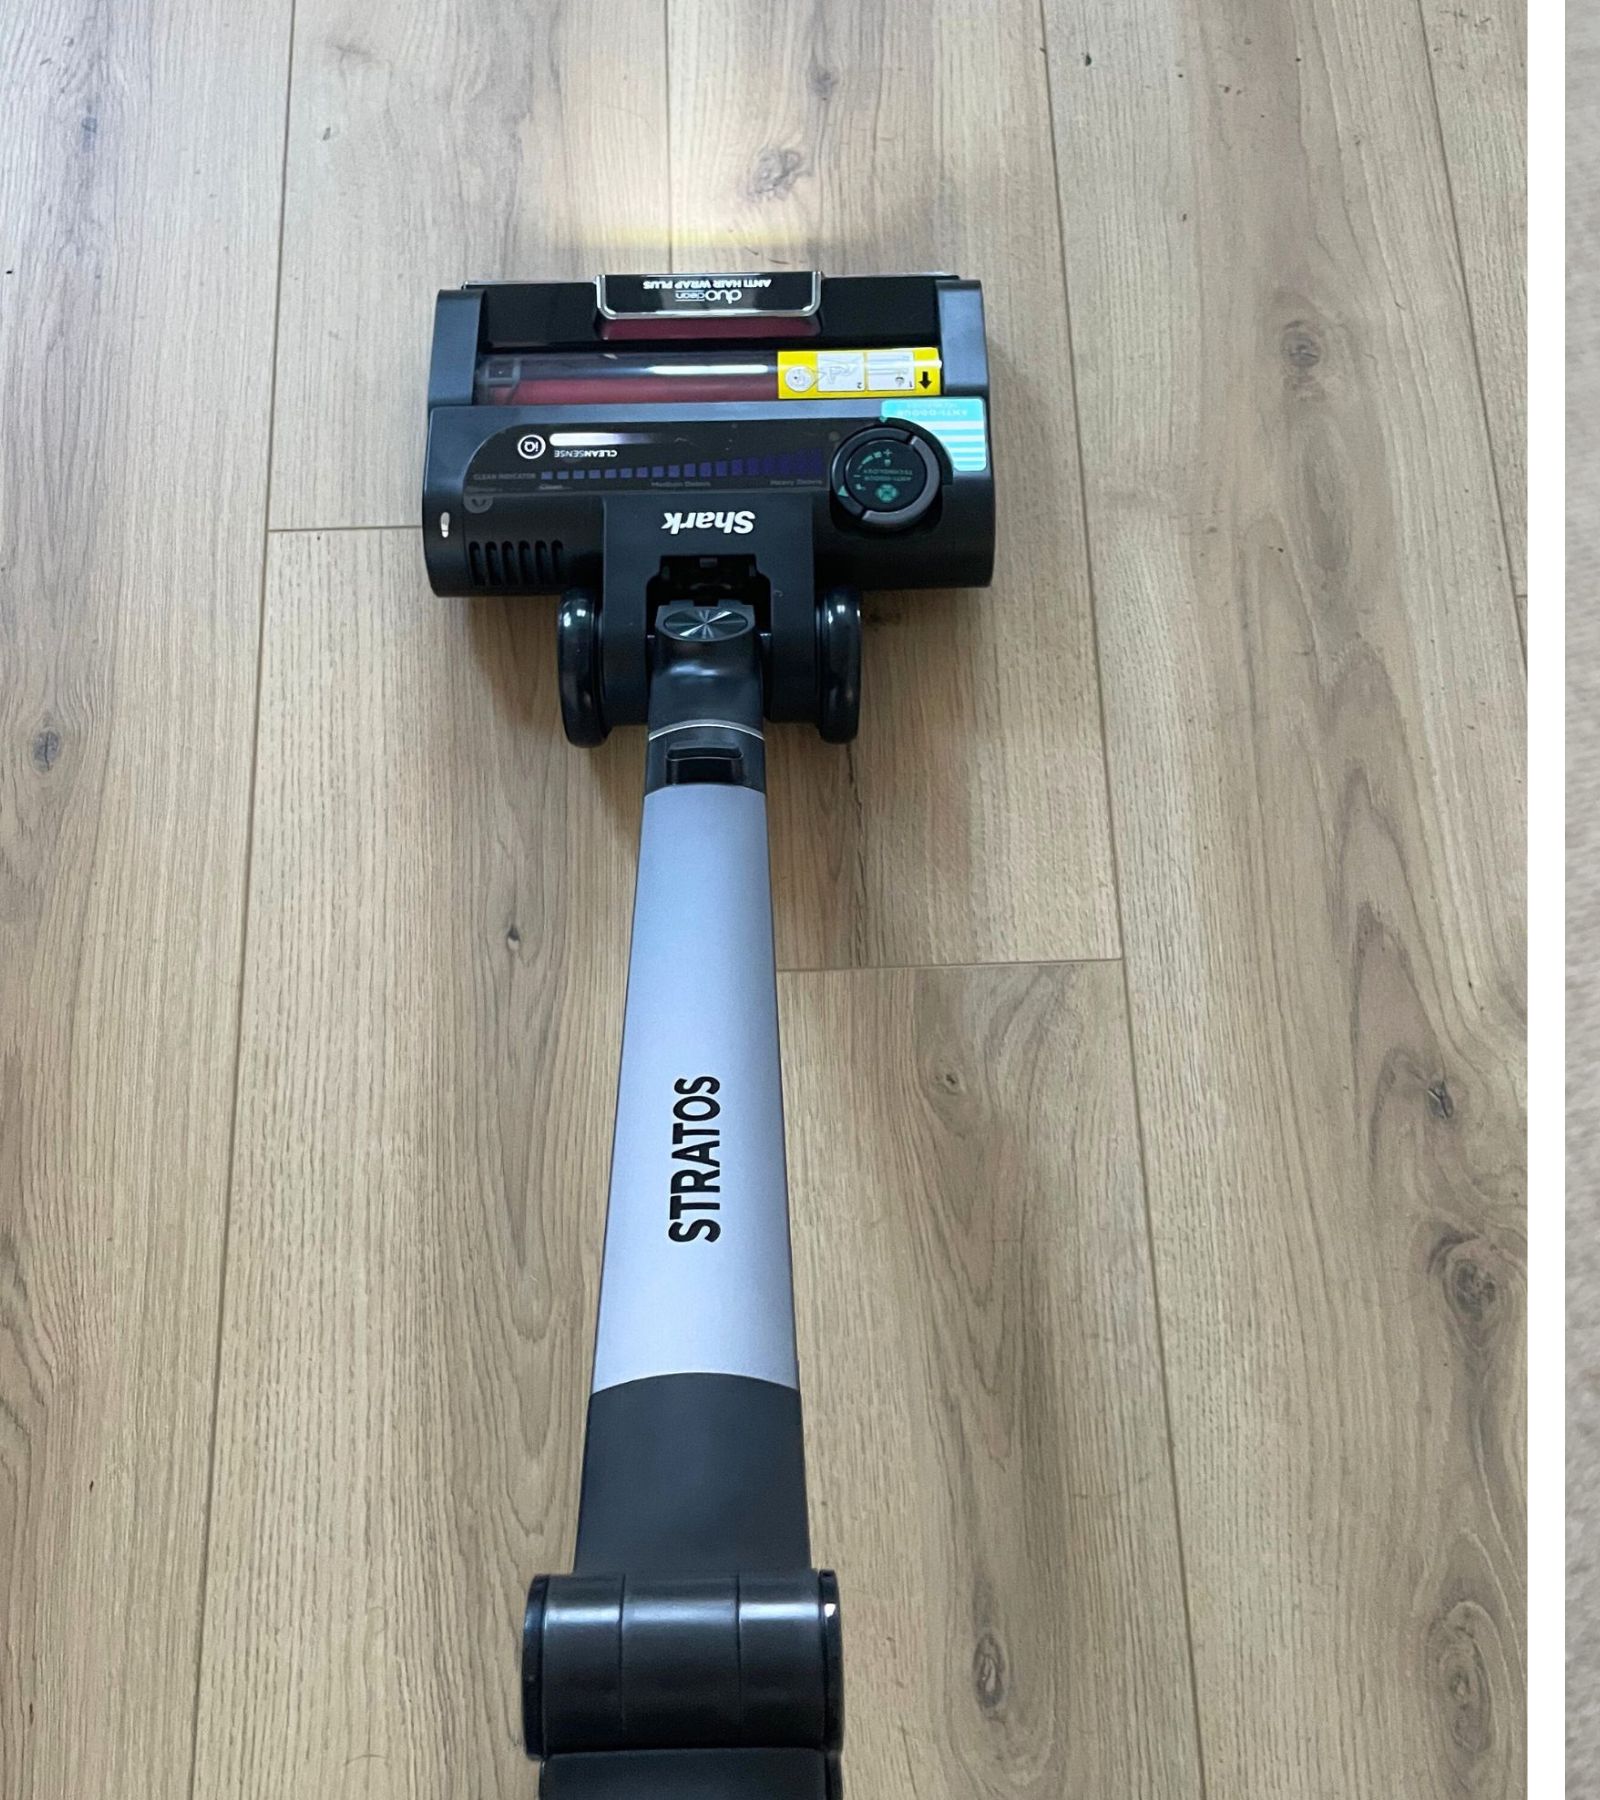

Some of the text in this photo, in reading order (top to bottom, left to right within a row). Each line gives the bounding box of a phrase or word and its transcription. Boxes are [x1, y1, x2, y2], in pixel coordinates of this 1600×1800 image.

[643, 279, 772, 290] ANTI HAIR WRAP PLUS
[661, 511, 756, 534] Shark
[668, 1076, 721, 1242] STRATOS
